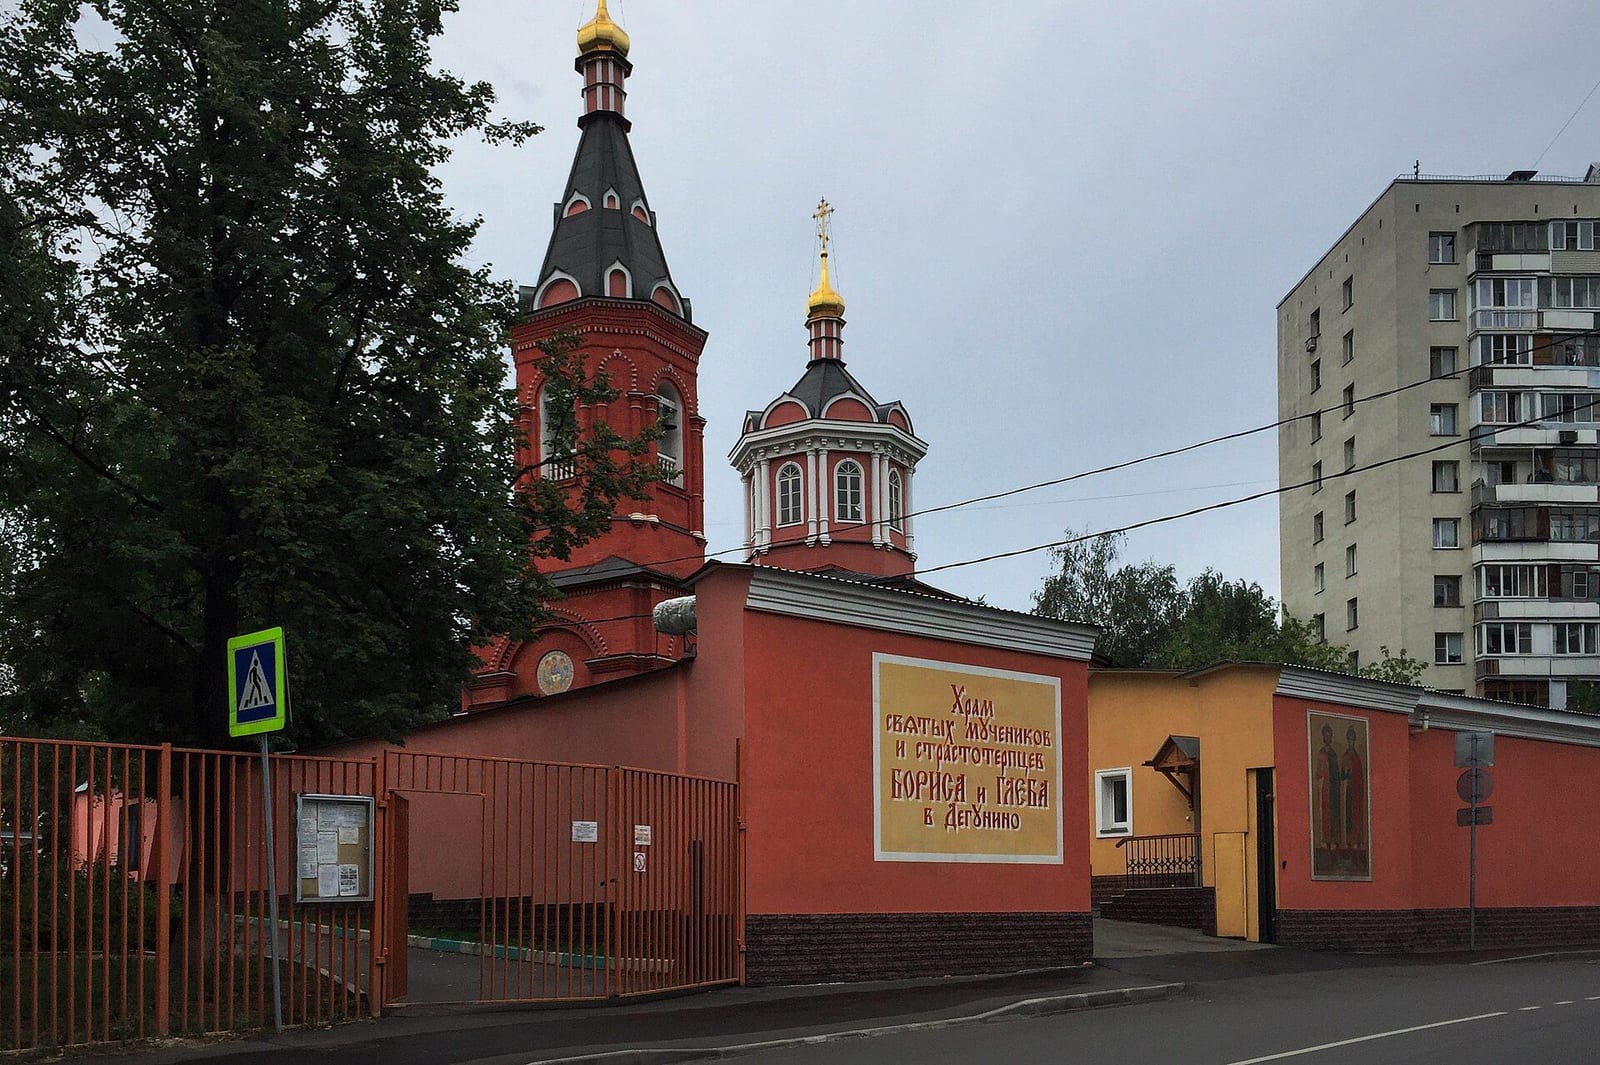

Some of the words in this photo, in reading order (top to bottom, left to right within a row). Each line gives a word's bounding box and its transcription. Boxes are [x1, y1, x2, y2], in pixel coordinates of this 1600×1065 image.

[951, 684, 995, 725] Храм
[896, 739, 907, 758] и
[916, 741, 1045, 776] страстотерпцев
[891, 768, 967, 803] БОРИСА
[977, 786, 987, 804] и
[996, 776, 1050, 809] ГЛЕБА
[924, 807, 935, 826] в
